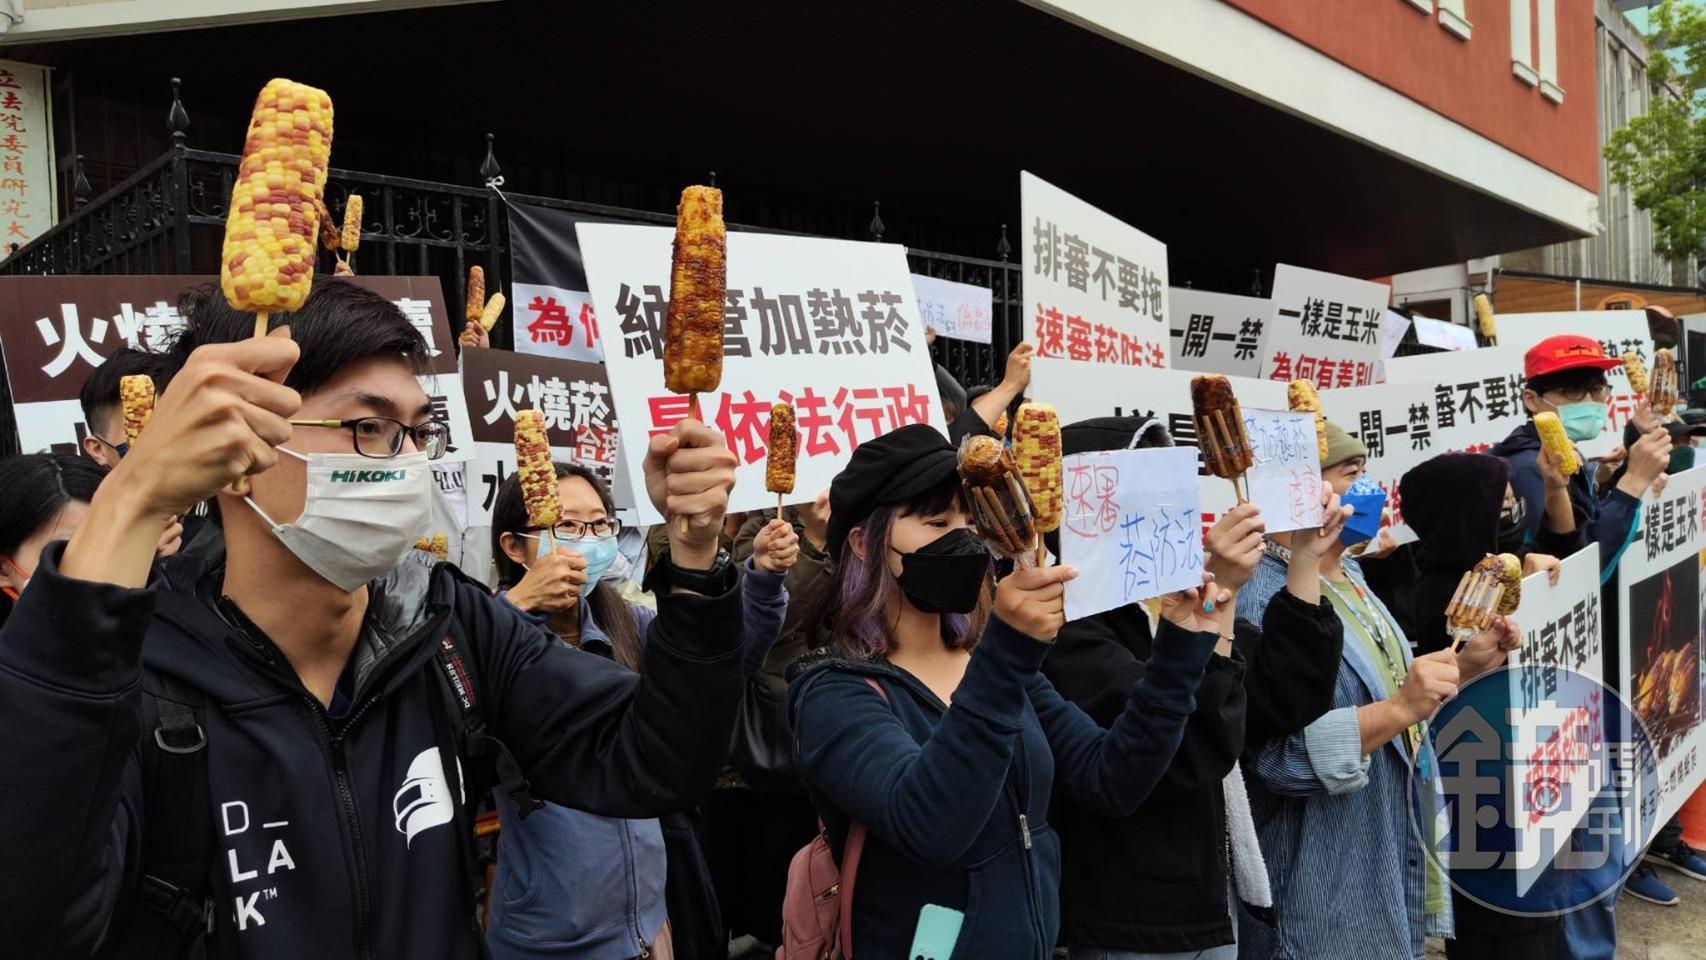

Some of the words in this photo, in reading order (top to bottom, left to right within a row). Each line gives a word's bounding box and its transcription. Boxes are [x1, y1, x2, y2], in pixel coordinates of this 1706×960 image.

[1033, 216, 1163, 323] 排審不要拖
[1036, 302, 1166, 369] 速審菸防法
[1278, 296, 1380, 345] 一樣是玉米
[483, 370, 611, 432] 火燒菸
[1269, 351, 1374, 391] 為何有差別
[1119, 507, 1203, 602] 菸防法
[1633, 490, 1698, 562] 一樣是玉米
